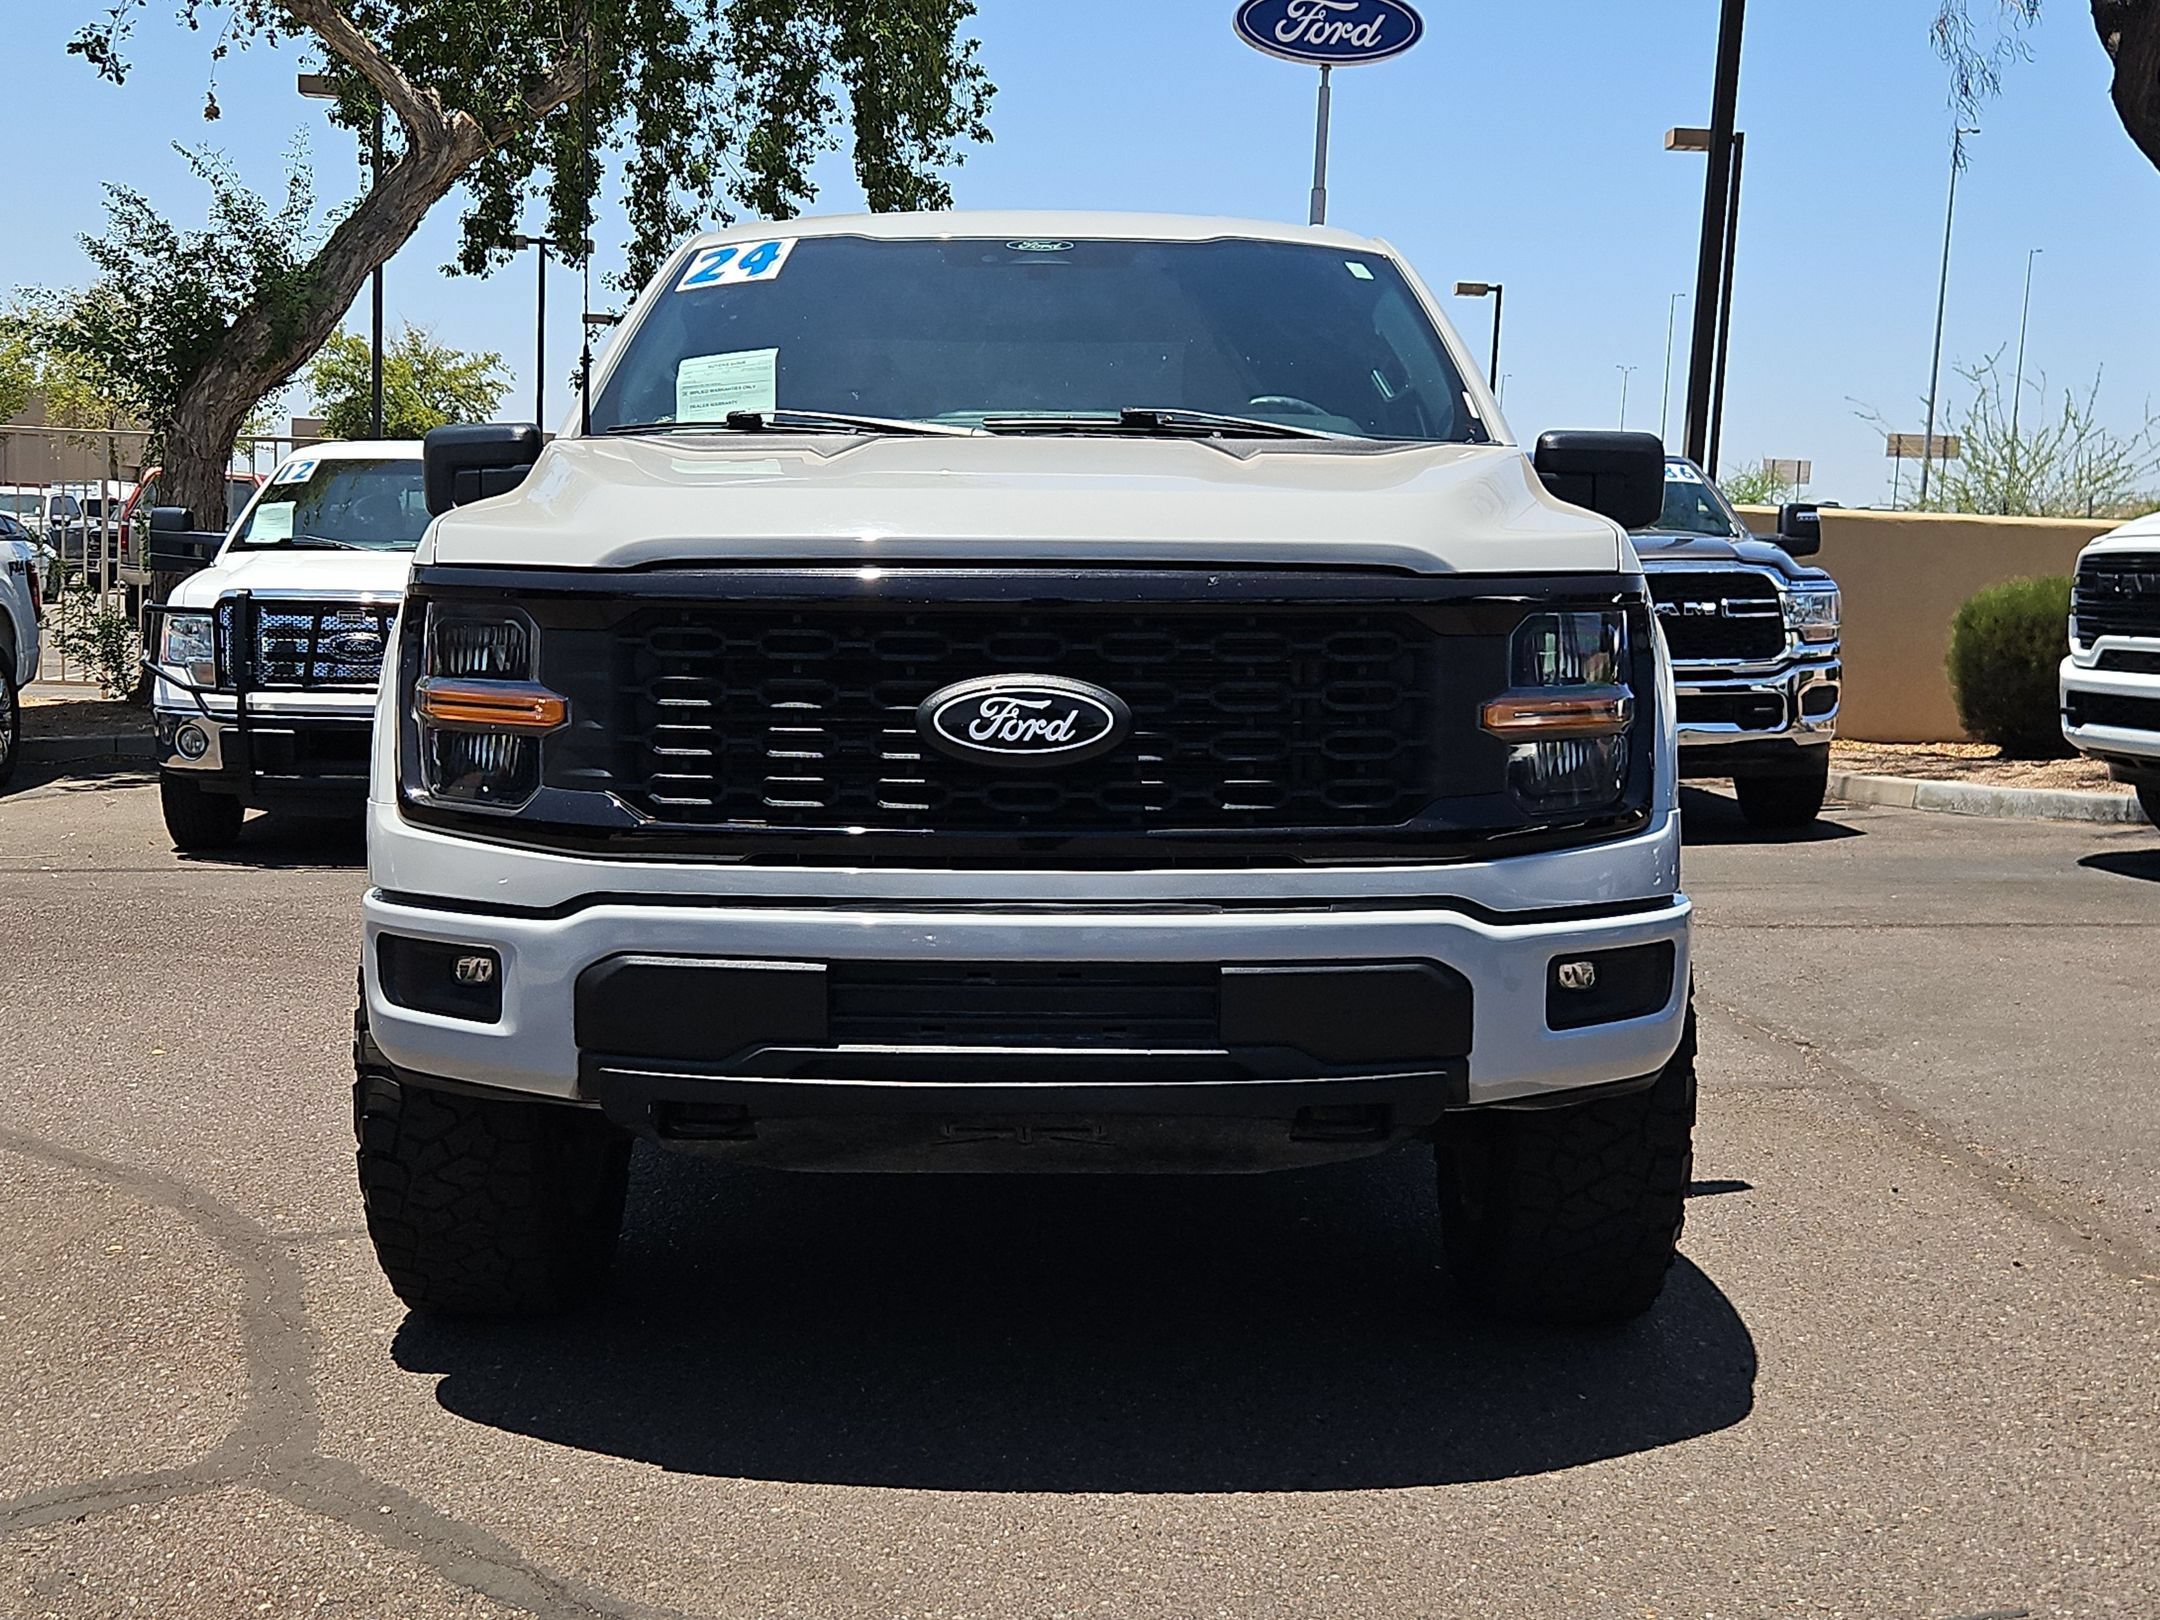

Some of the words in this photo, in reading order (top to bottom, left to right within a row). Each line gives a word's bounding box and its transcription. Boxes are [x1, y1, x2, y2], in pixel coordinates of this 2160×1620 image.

[1274, 0, 1386, 47] Ford
[1018, 241, 1062, 250] Ford
[683, 241, 783, 285] 24
[278, 461, 315, 481] 12
[1653, 602, 1716, 616] AM
[968, 696, 1079, 741] Ford
